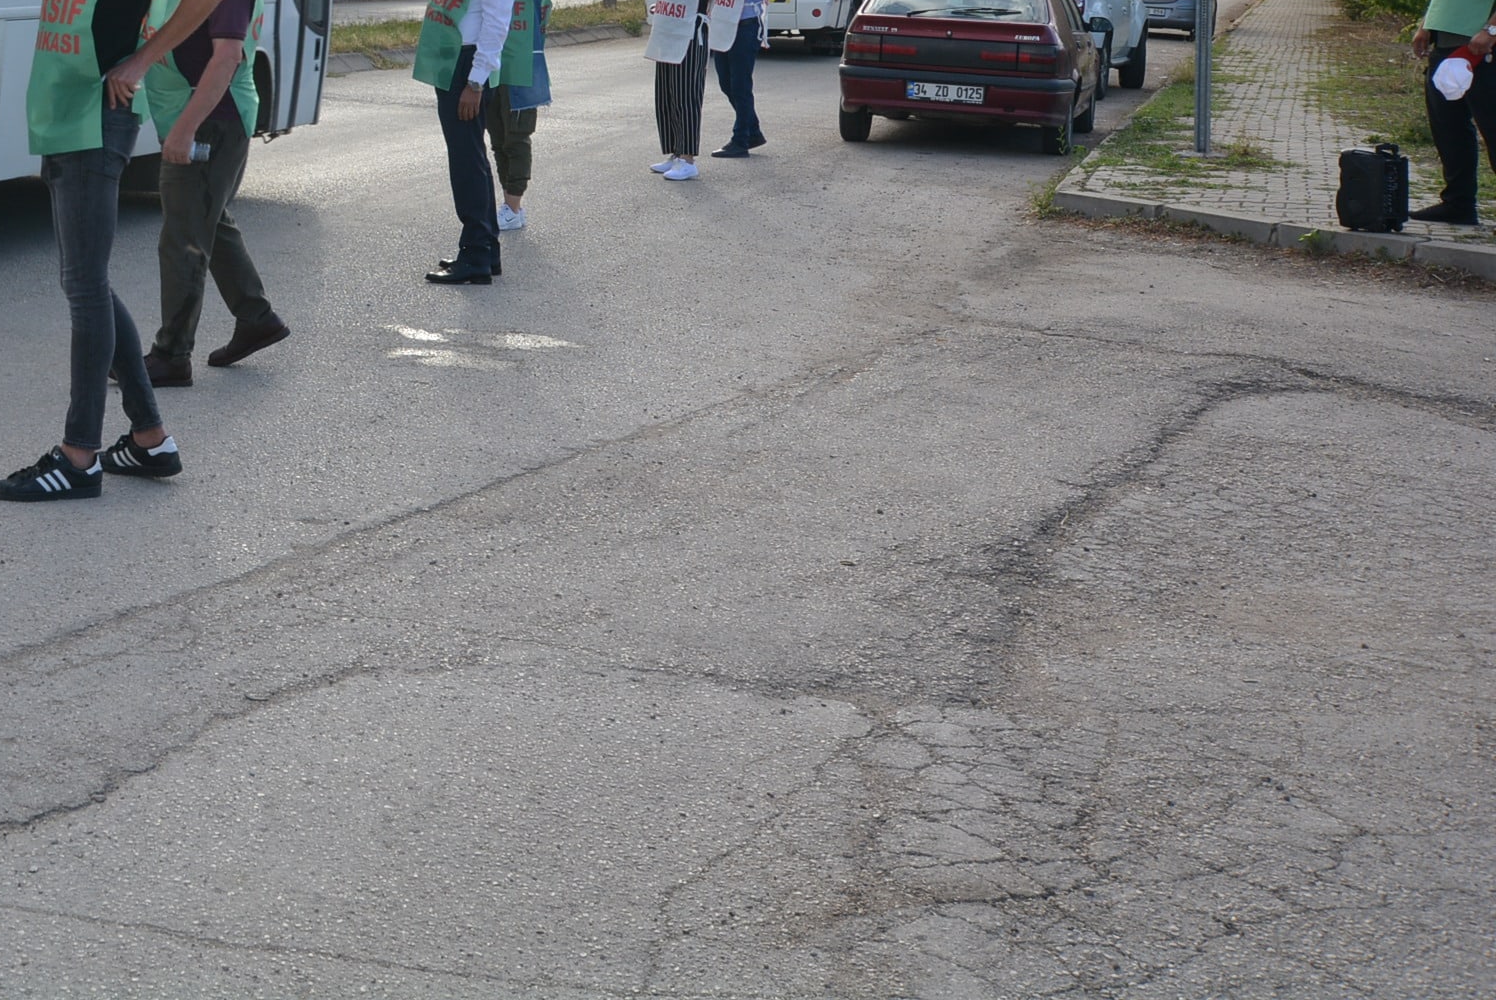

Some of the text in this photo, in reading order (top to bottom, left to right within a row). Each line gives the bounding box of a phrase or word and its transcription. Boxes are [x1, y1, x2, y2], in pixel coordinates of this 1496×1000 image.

[914, 83, 927, 95] 34
[935, 85, 949, 97] ZD
[956, 87, 983, 100] 0125
